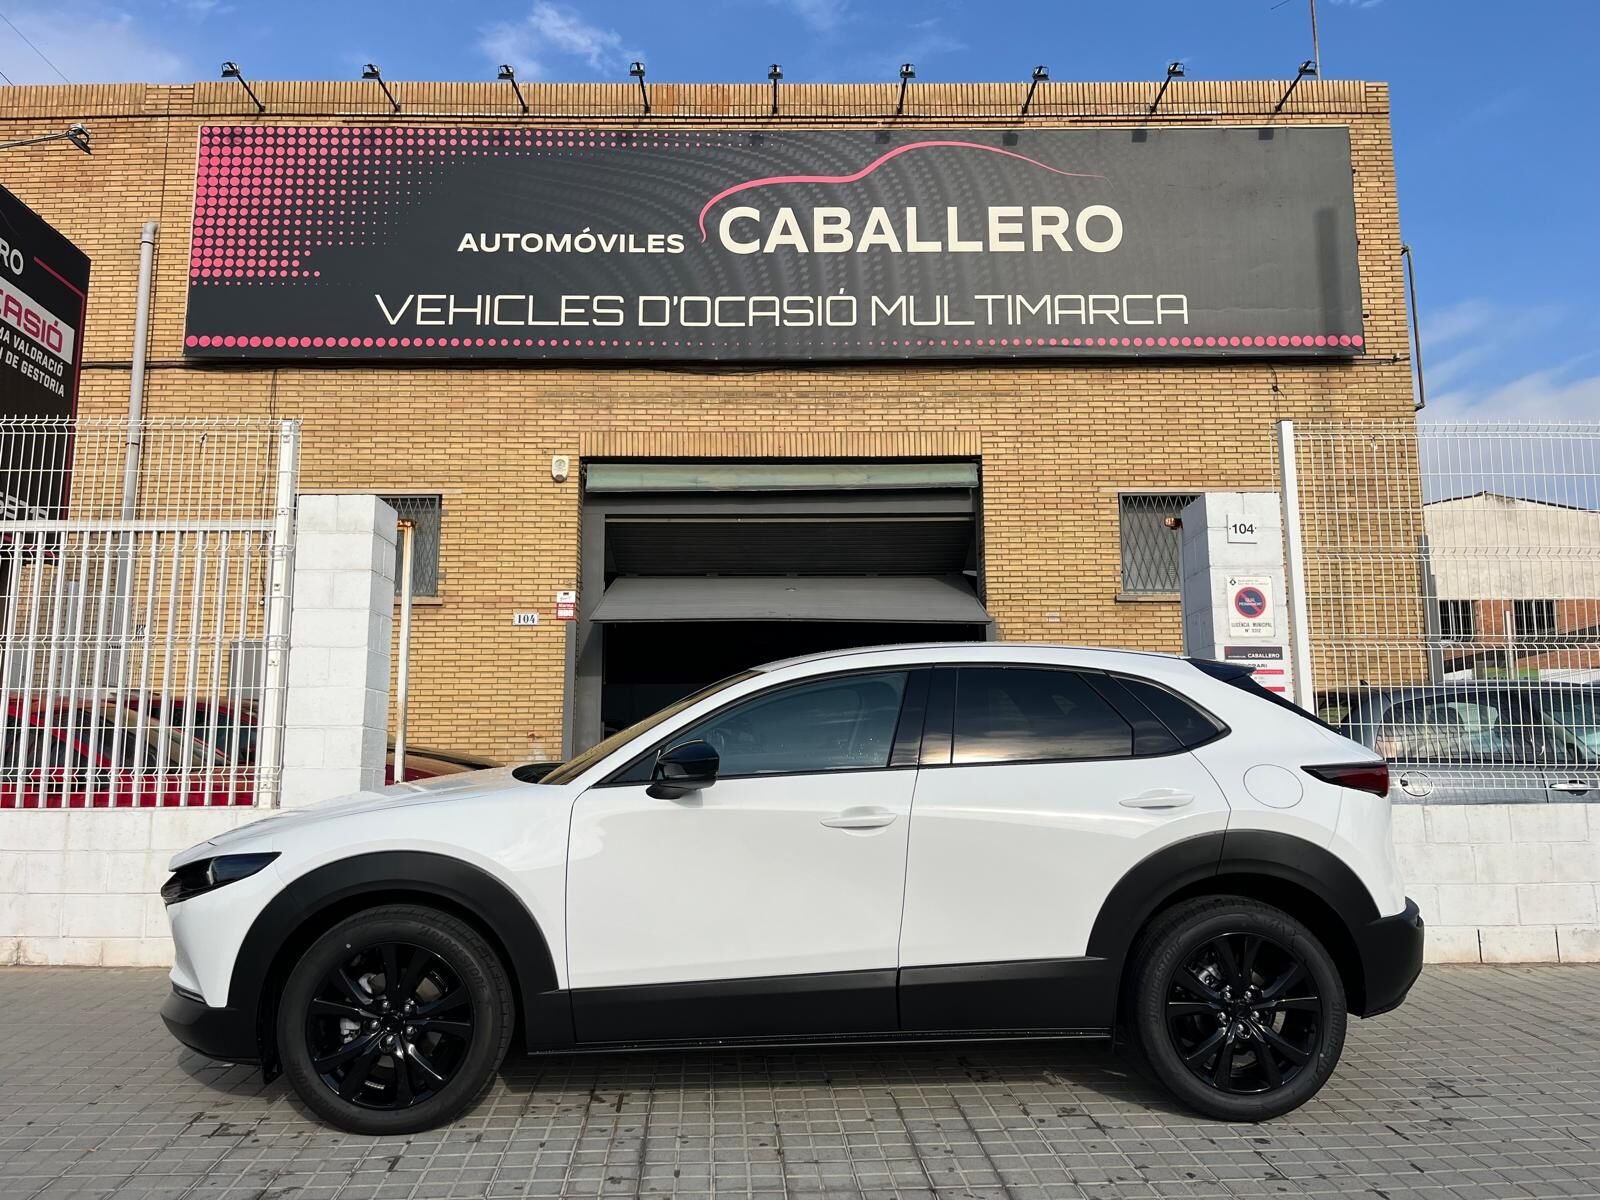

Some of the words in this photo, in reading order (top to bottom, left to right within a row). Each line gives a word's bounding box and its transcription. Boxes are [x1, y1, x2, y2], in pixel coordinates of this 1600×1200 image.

[457, 227, 685, 254] AUTOMÓVILES
[718, 205, 1124, 255] CABALLERO
[374, 294, 625, 327] VEHICLES
[638, 287, 858, 328] D'OCASIÓ
[871, 294, 1190, 326] MULTIMARCA
[5, 350, 19, 369] DE
[21, 360, 65, 398] GESTORIA
[13, 334, 64, 377] VALORACIÓ
[1232, 523, 1254, 535] 104
[518, 614, 536, 624] 104
